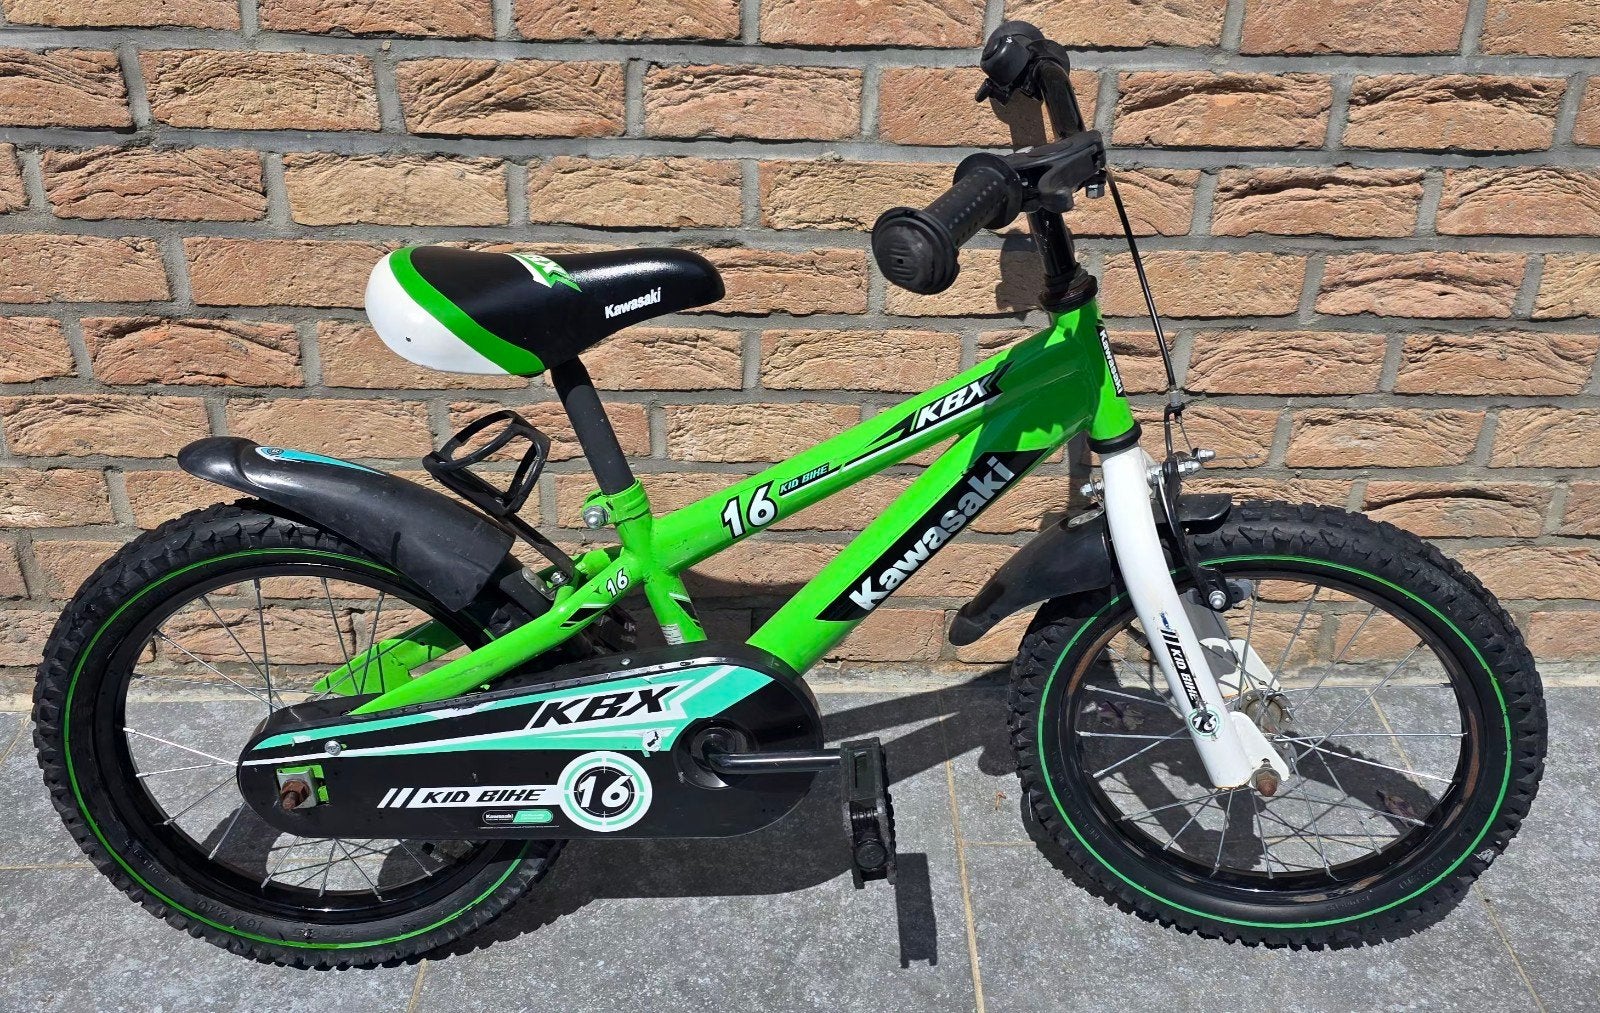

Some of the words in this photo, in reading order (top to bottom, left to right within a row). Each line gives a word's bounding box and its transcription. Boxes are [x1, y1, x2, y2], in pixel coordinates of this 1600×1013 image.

[604, 286, 662, 319] Kawasaki
[1099, 329, 1124, 393] Kawasaki
[915, 374, 990, 430] KBX
[779, 480, 797, 494] KID
[801, 464, 829, 483] BIKE
[721, 481, 777, 540] 16
[848, 456, 1015, 611] Kawasaki
[606, 567, 630, 598] 16
[1170, 648, 1187, 671] KID
[1181, 673, 1198, 701] BIKE
[530, 684, 680, 730] KBX
[421, 789, 471, 804] KID
[476, 788, 546, 803] BIKE
[577, 774, 634, 808] 16
